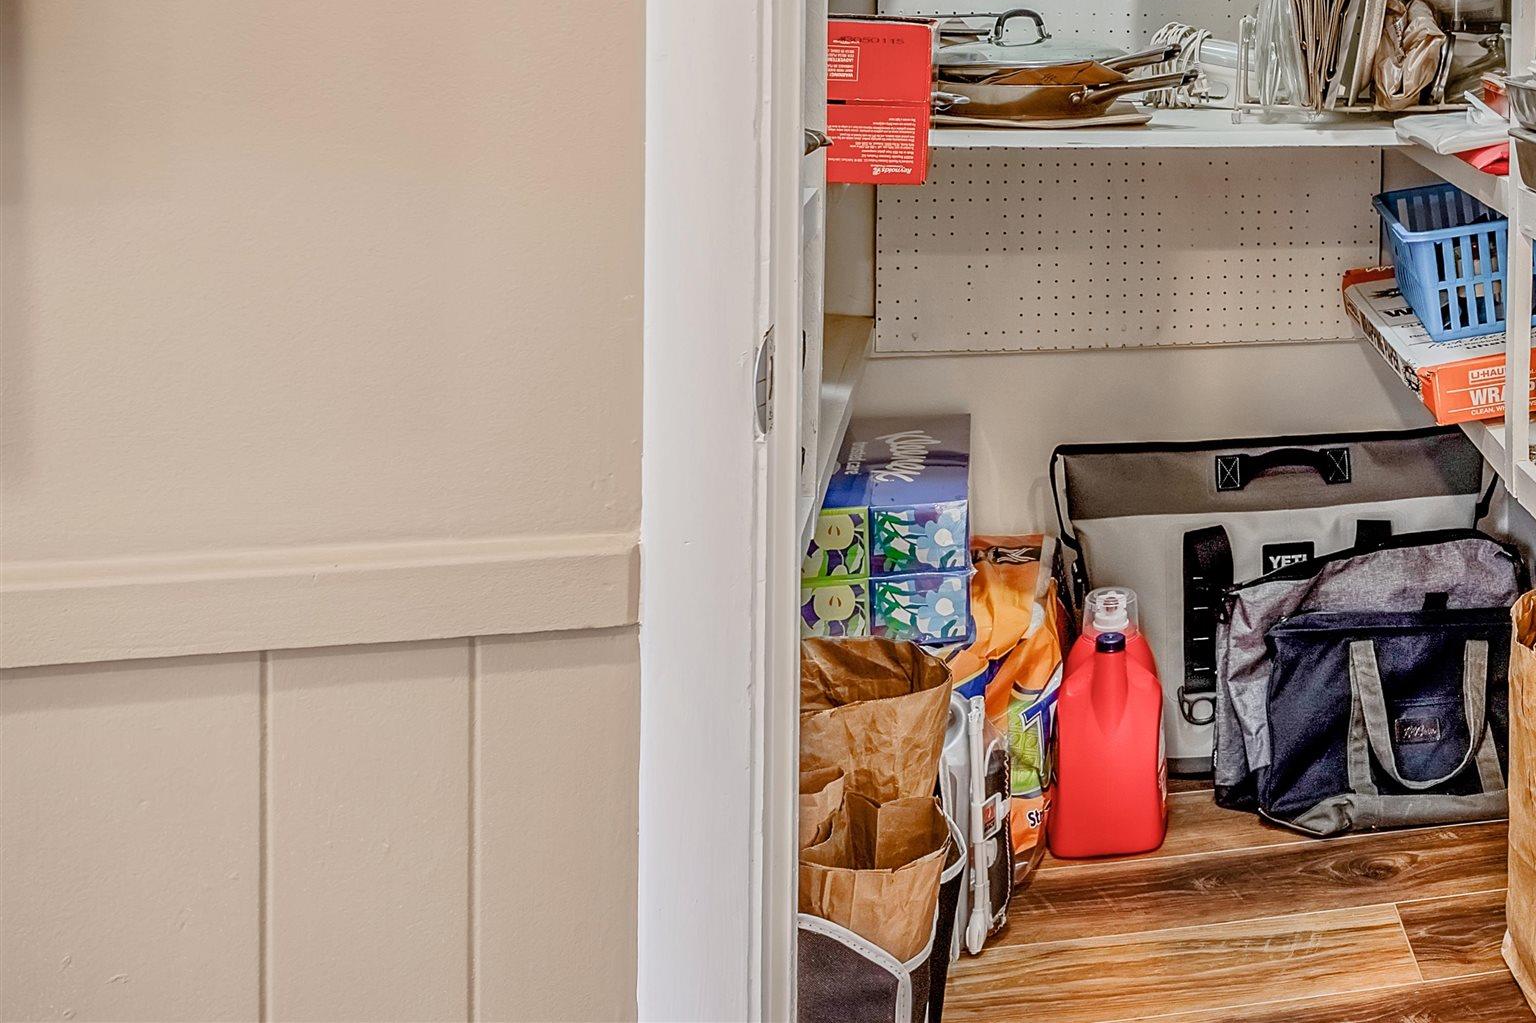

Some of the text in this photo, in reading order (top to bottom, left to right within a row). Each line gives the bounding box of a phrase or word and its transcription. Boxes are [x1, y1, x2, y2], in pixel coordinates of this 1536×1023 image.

[881, 166, 912, 175] Reynolds
[1471, 367, 1505, 379] U-HAU
[1471, 406, 1496, 416] CLEAN,
[870, 429, 941, 483] Kleenex
[1268, 553, 1308, 569] YETI
